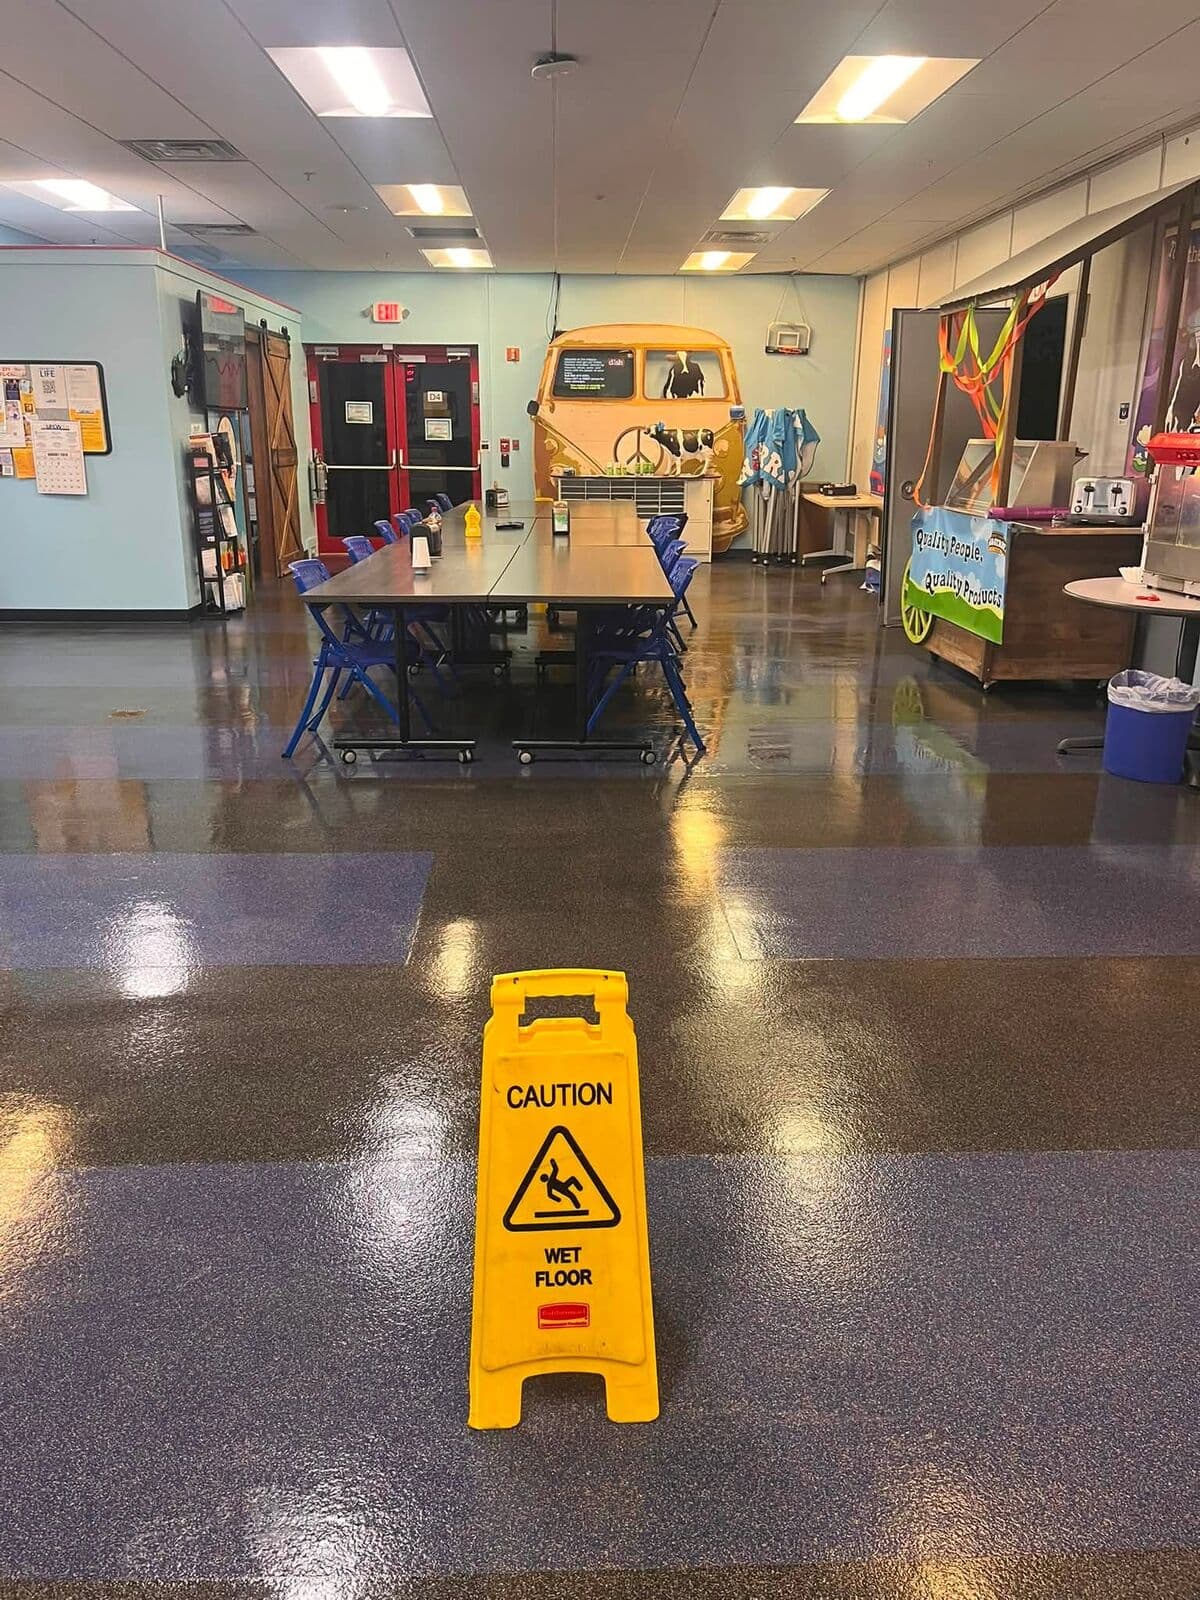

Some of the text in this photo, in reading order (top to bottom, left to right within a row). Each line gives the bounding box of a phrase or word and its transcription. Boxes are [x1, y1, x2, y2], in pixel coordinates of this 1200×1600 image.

[378, 304, 398, 320] EXIT
[39, 369, 56, 378] LIFE
[429, 393, 441, 401] D4
[916, 529, 950, 557] Quality
[925, 570, 1002, 608] Quality Products
[507, 1082, 613, 1109] CAUTION
[544, 1247, 582, 1264] WET
[535, 1269, 593, 1287] FLOOR
